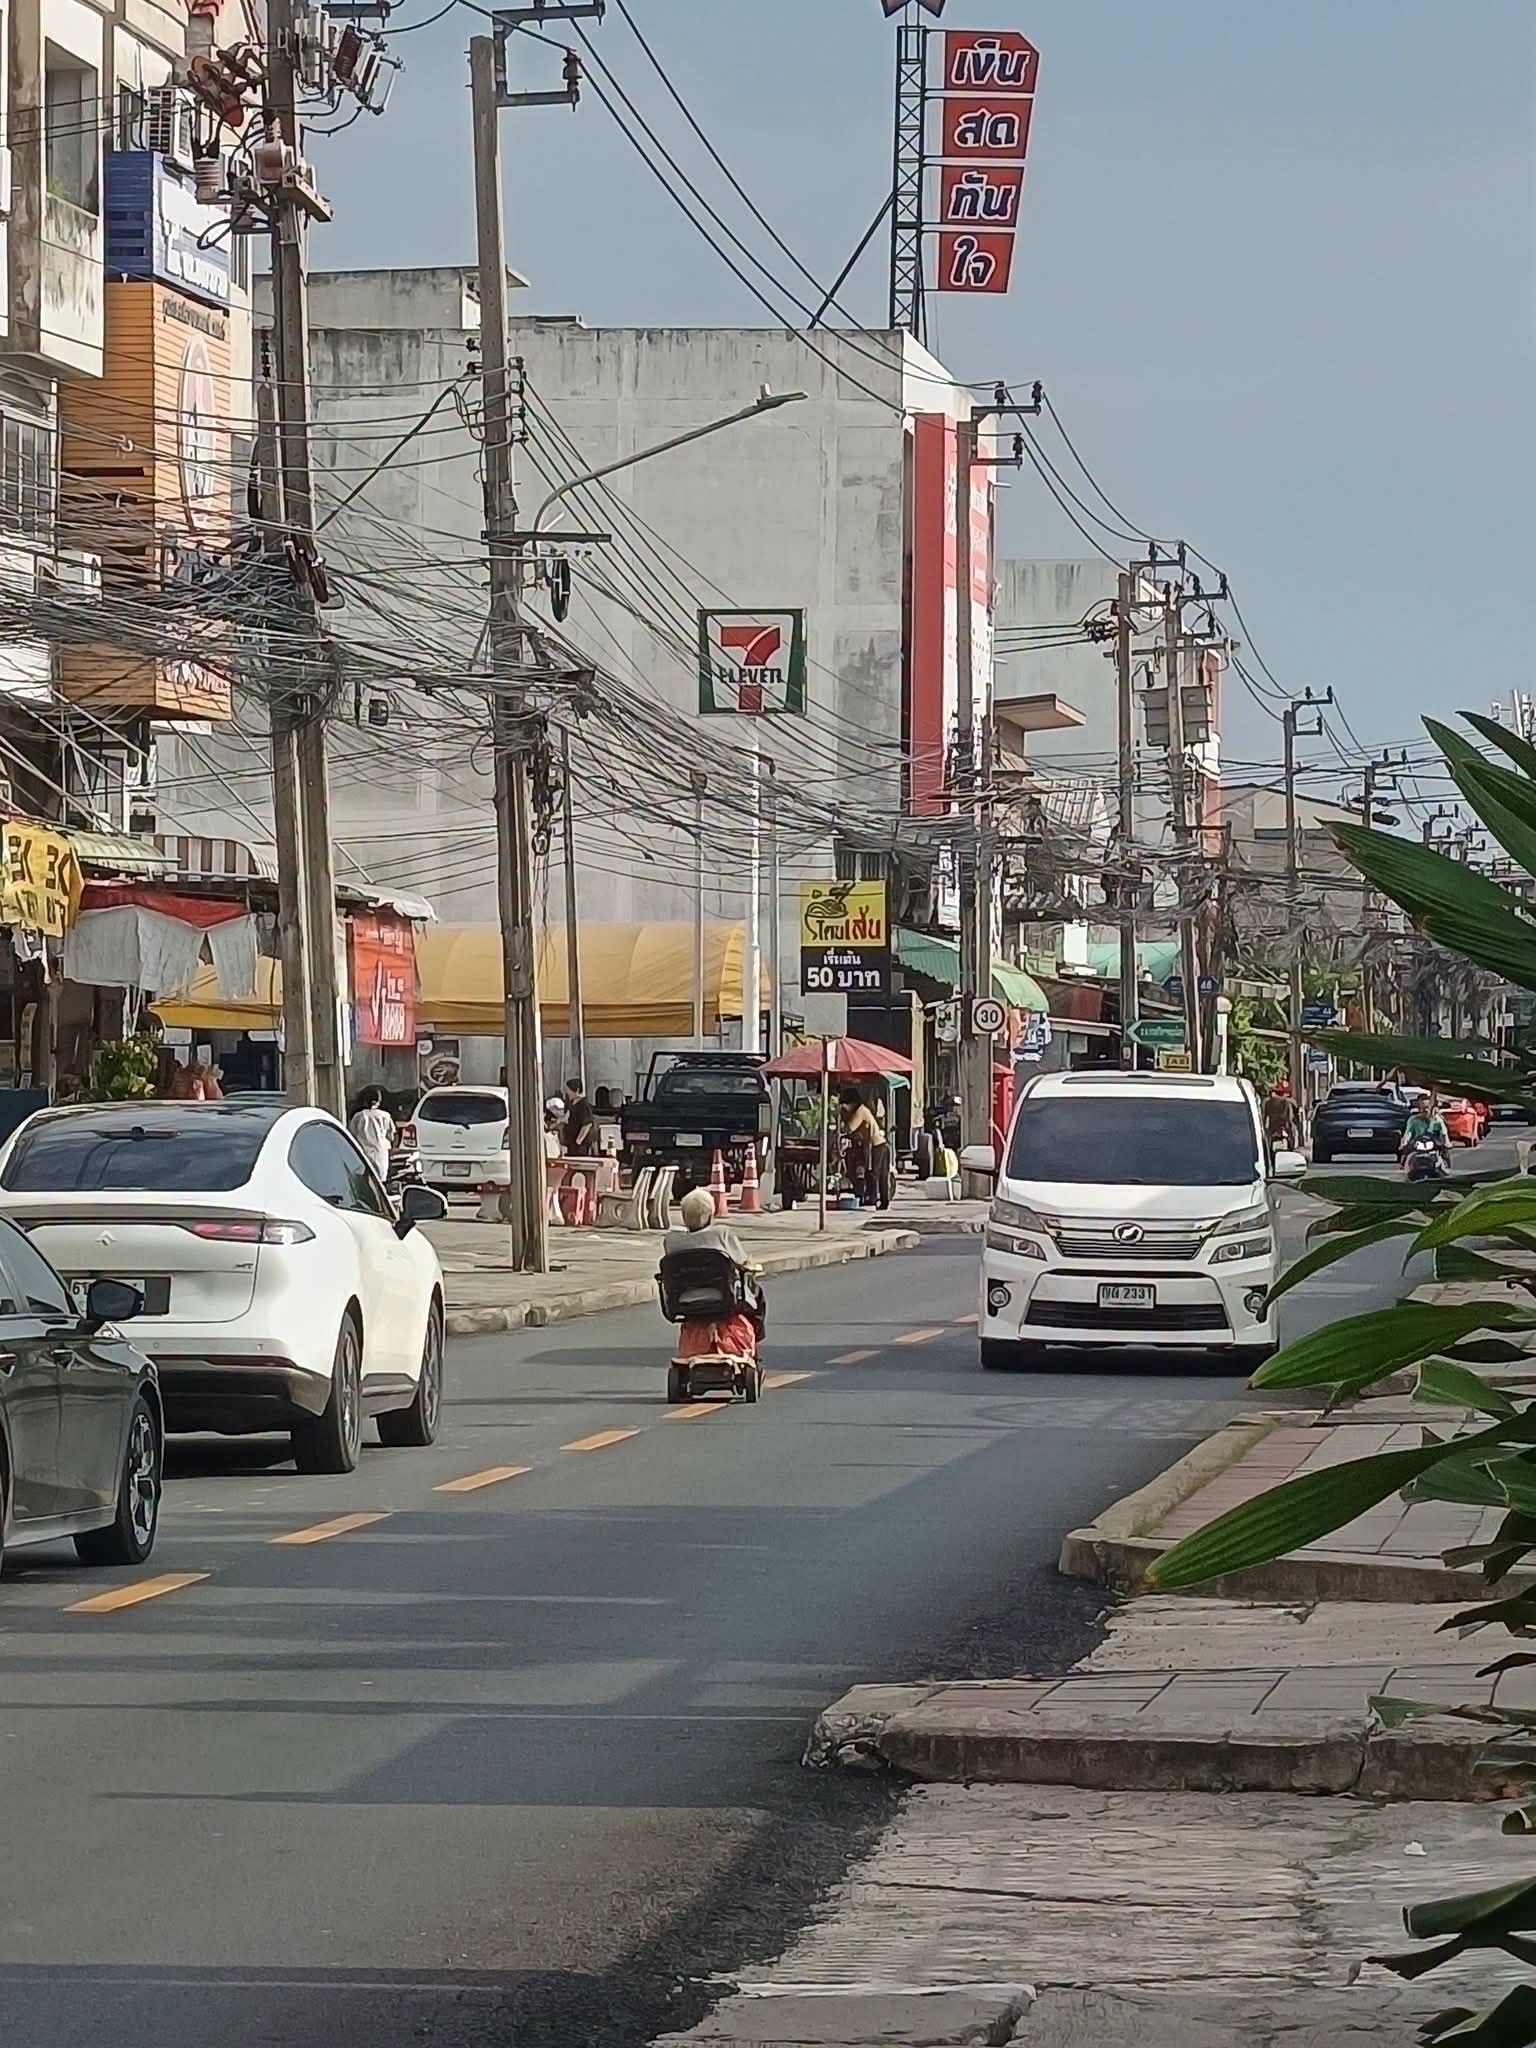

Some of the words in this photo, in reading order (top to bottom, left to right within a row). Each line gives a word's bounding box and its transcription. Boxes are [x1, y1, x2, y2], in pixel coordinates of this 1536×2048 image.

[951, 39, 1031, 84] เงิน
[954, 108, 1018, 147] สด
[948, 171, 1016, 219] ทัน
[950, 235, 995, 286] ใจ
[807, 966, 833, 987] 50
[838, 970, 881, 987] บาท
[980, 1009, 998, 1023] 30
